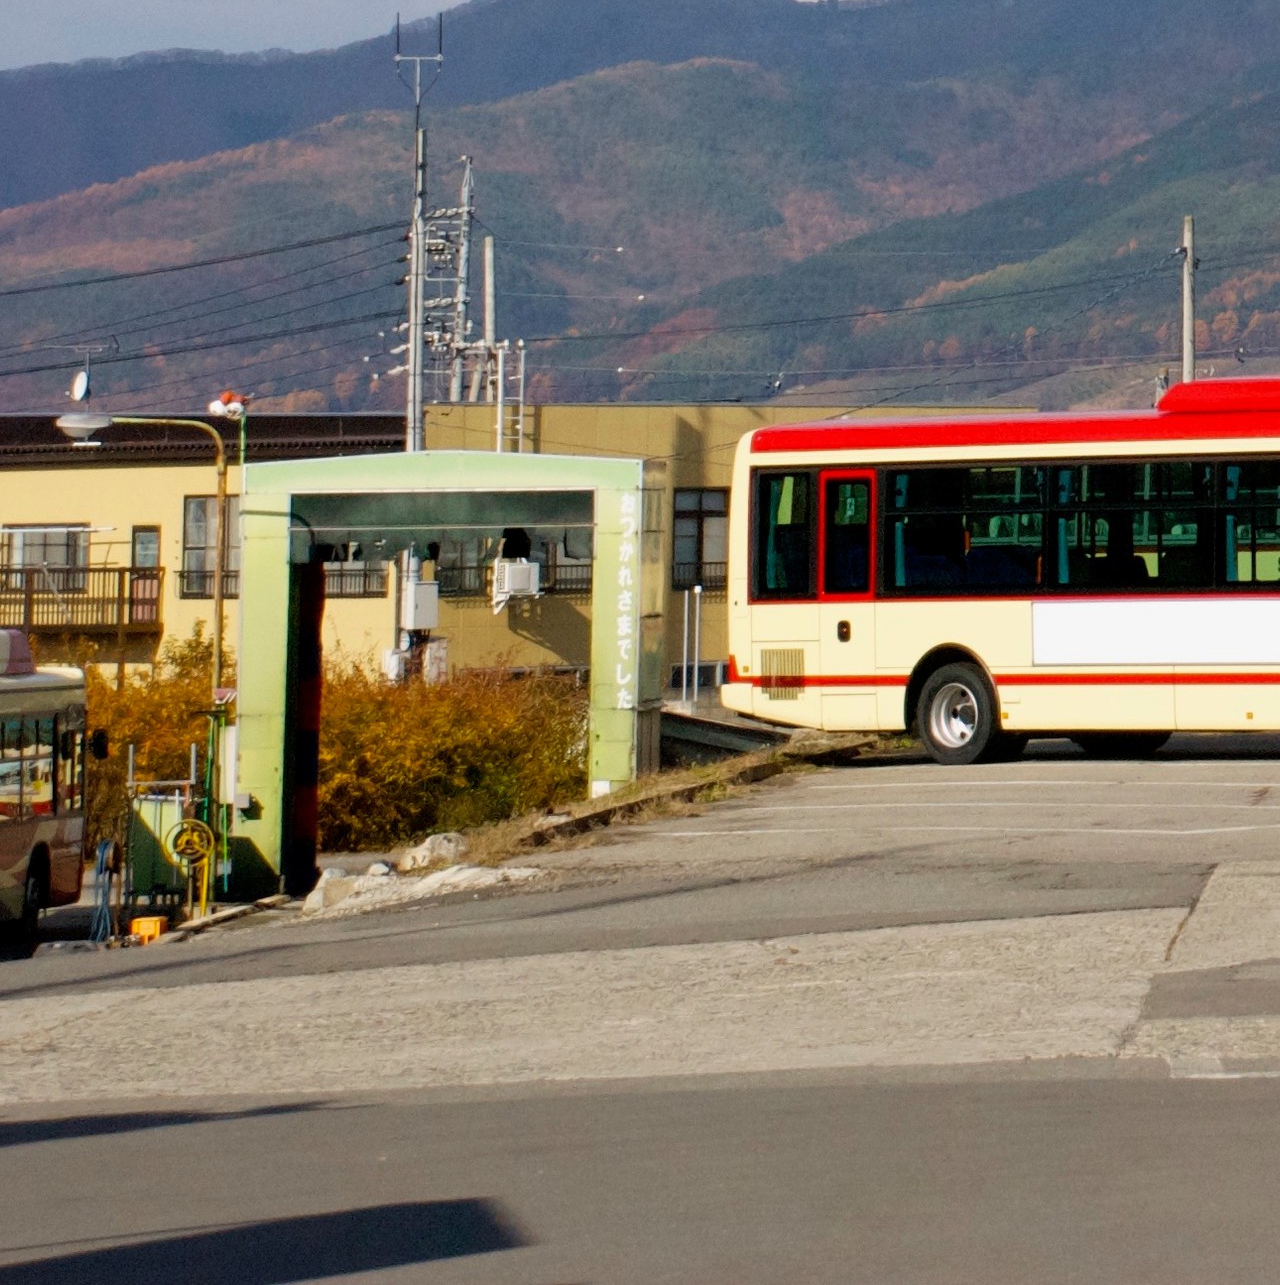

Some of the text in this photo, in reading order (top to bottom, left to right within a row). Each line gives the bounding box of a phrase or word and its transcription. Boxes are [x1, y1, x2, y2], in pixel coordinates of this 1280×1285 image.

[614, 492, 637, 710] おつかれさまでした
